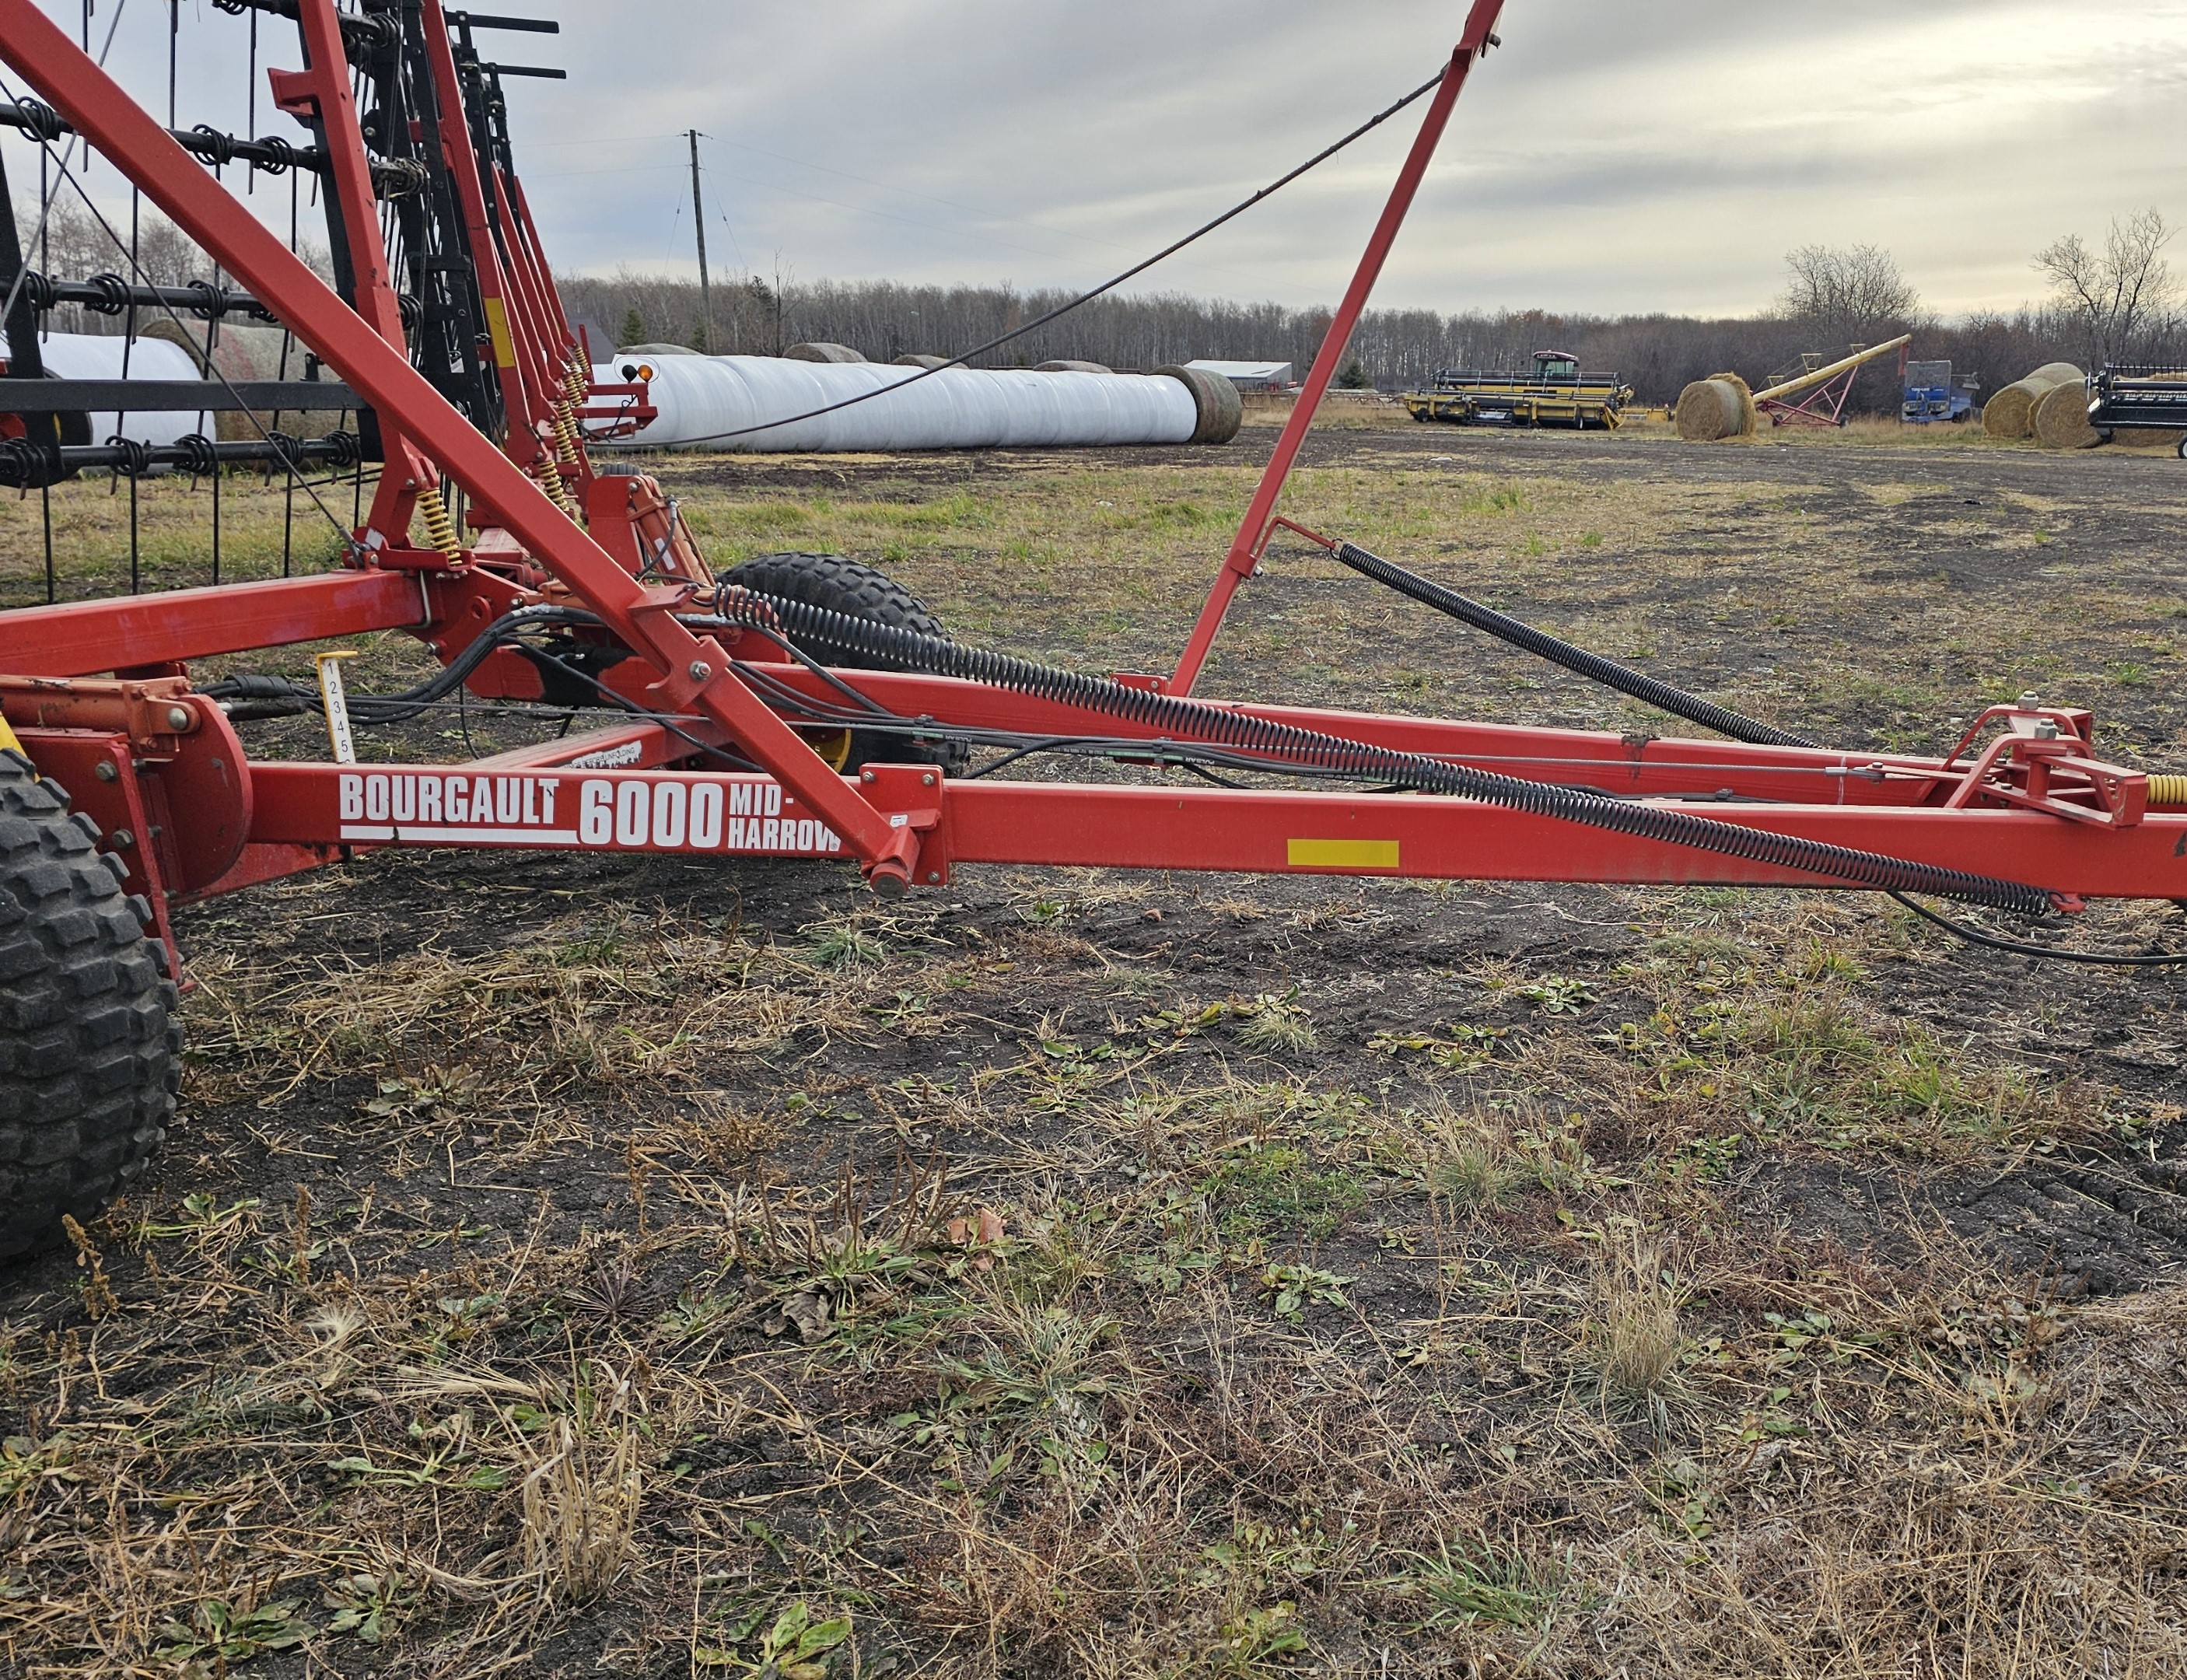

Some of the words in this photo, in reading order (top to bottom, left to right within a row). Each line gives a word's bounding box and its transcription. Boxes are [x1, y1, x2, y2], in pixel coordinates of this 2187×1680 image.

[327, 661, 334, 675] 1
[330, 681, 338, 695] 2
[334, 701, 341, 714] 3
[338, 719, 345, 733] 4
[341, 740, 348, 753] 5
[1184, 757, 1215, 765] PULSAR
[339, 774, 559, 824] BOURGAULT
[579, 779, 723, 848] 6000
